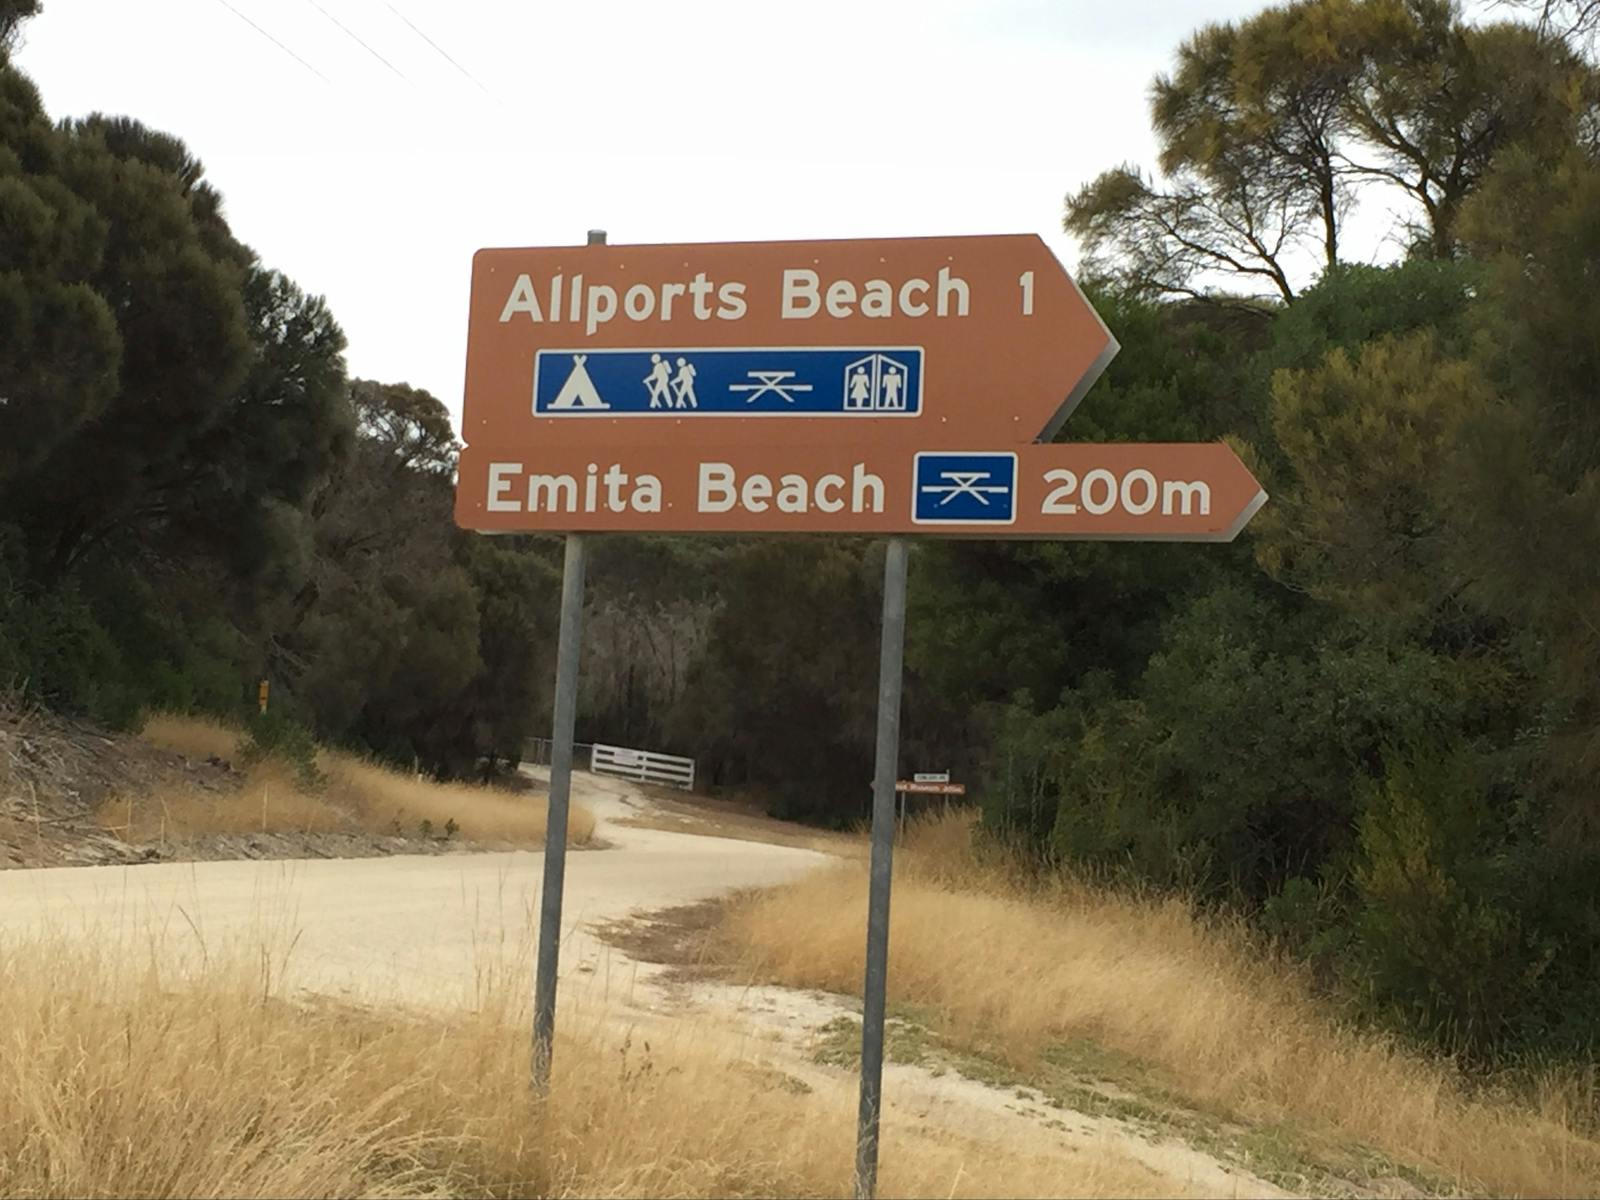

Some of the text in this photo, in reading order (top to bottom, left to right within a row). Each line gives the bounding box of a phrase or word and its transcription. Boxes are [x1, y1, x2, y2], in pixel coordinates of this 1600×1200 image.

[499, 267, 1034, 336] Allports Beach 1
[487, 463, 1211, 515] Emita Beach 200m
